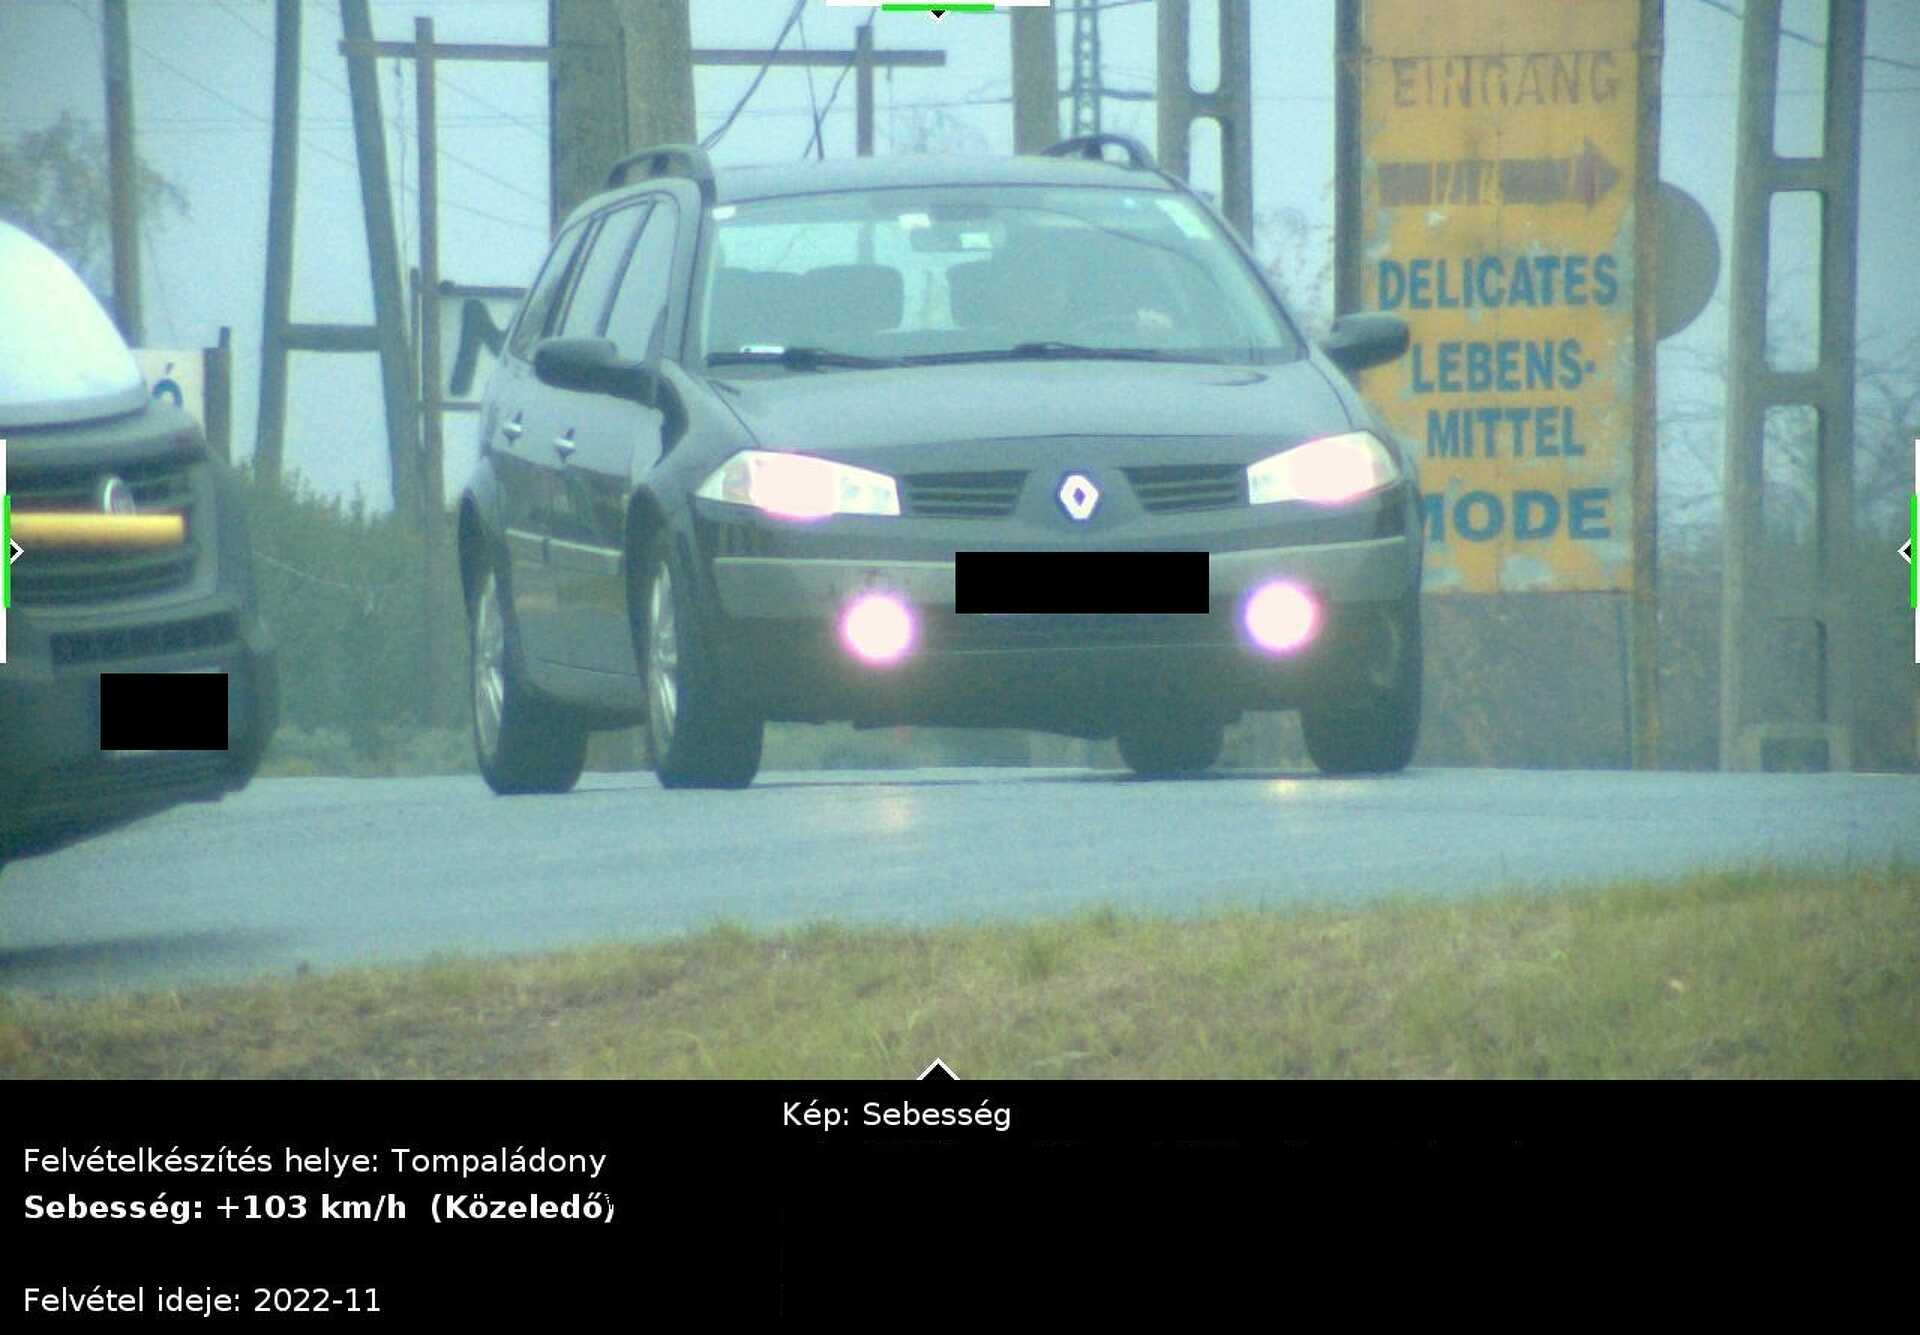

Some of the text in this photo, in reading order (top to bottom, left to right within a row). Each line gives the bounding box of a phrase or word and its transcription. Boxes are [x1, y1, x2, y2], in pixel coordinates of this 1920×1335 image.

[1391, 52, 1617, 108] EINGANG
[1377, 254, 1618, 310] DELICATES
[1426, 406, 1585, 458] MITTEL
